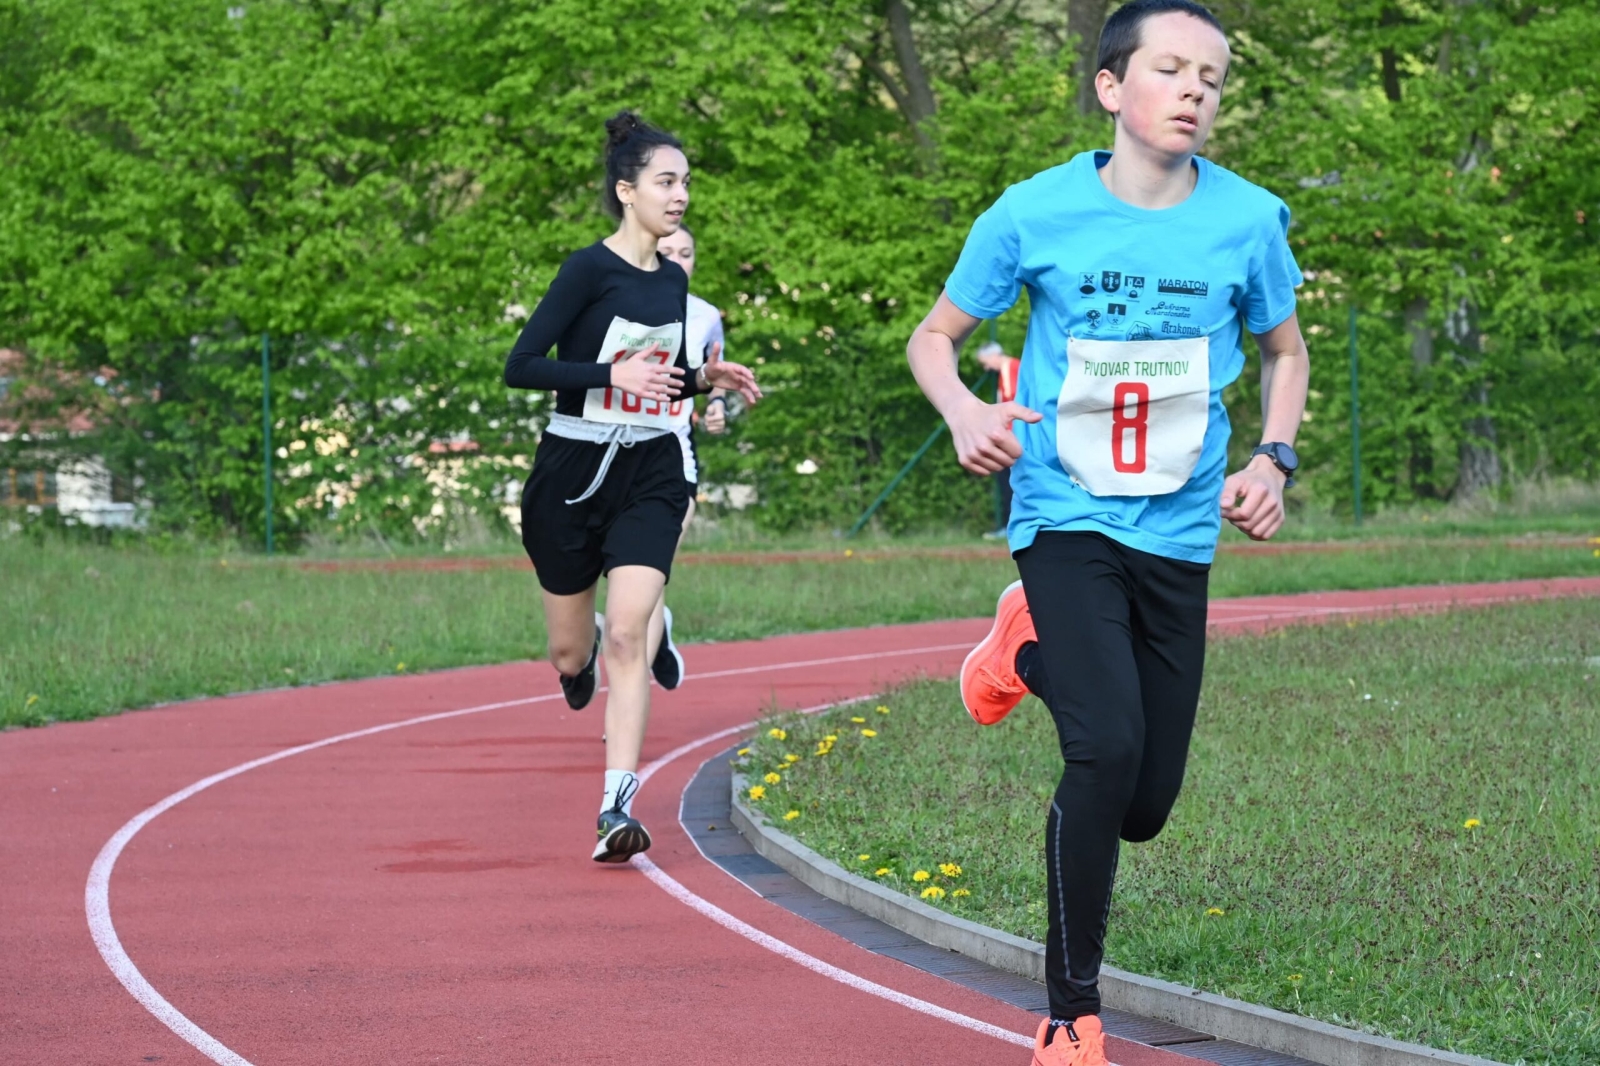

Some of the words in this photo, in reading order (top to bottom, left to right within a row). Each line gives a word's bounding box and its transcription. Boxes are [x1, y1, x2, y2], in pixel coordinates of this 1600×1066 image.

[1158, 278, 1209, 291] MARATON
[1084, 360, 1130, 377] PIVOVAR
[1134, 360, 1189, 377] TRUTNOV
[1112, 382, 1149, 474] 8
